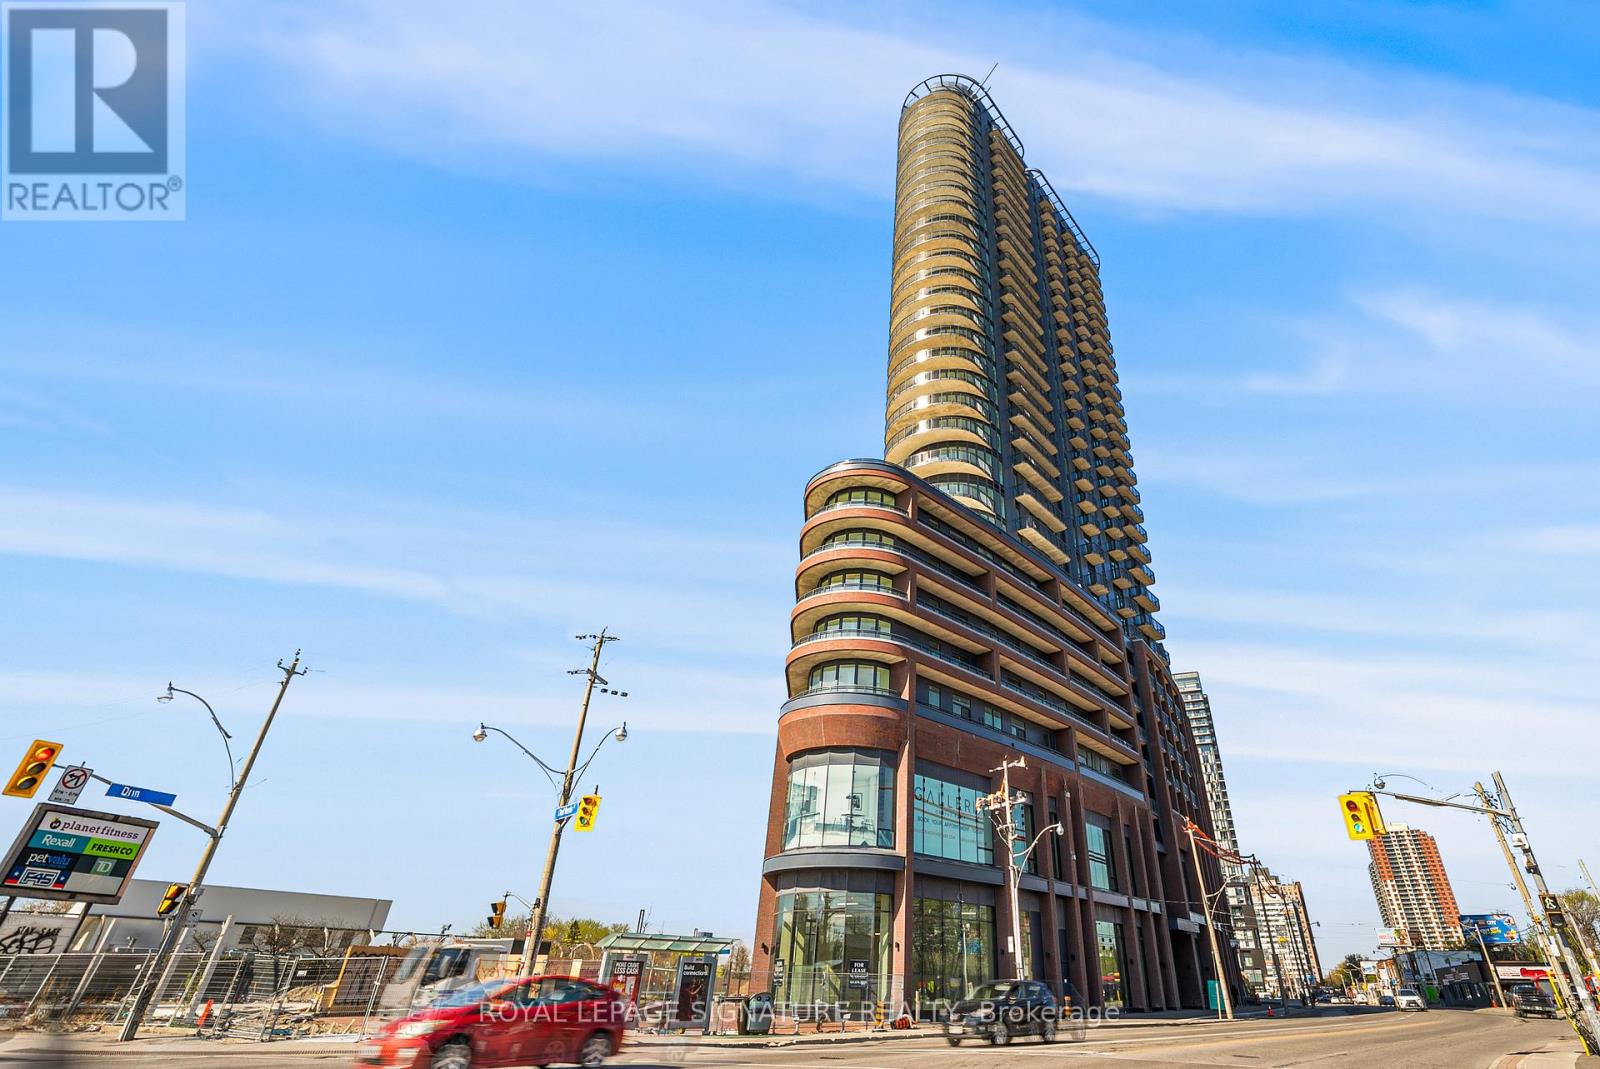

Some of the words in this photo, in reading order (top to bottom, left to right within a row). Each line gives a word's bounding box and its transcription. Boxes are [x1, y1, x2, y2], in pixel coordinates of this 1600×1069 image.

[62, 820, 100, 834] planet
[100, 826, 139, 840] fitness
[41, 834, 76, 848] Rexall
[96, 860, 112, 873] TD
[20, 871, 56, 887] F45
